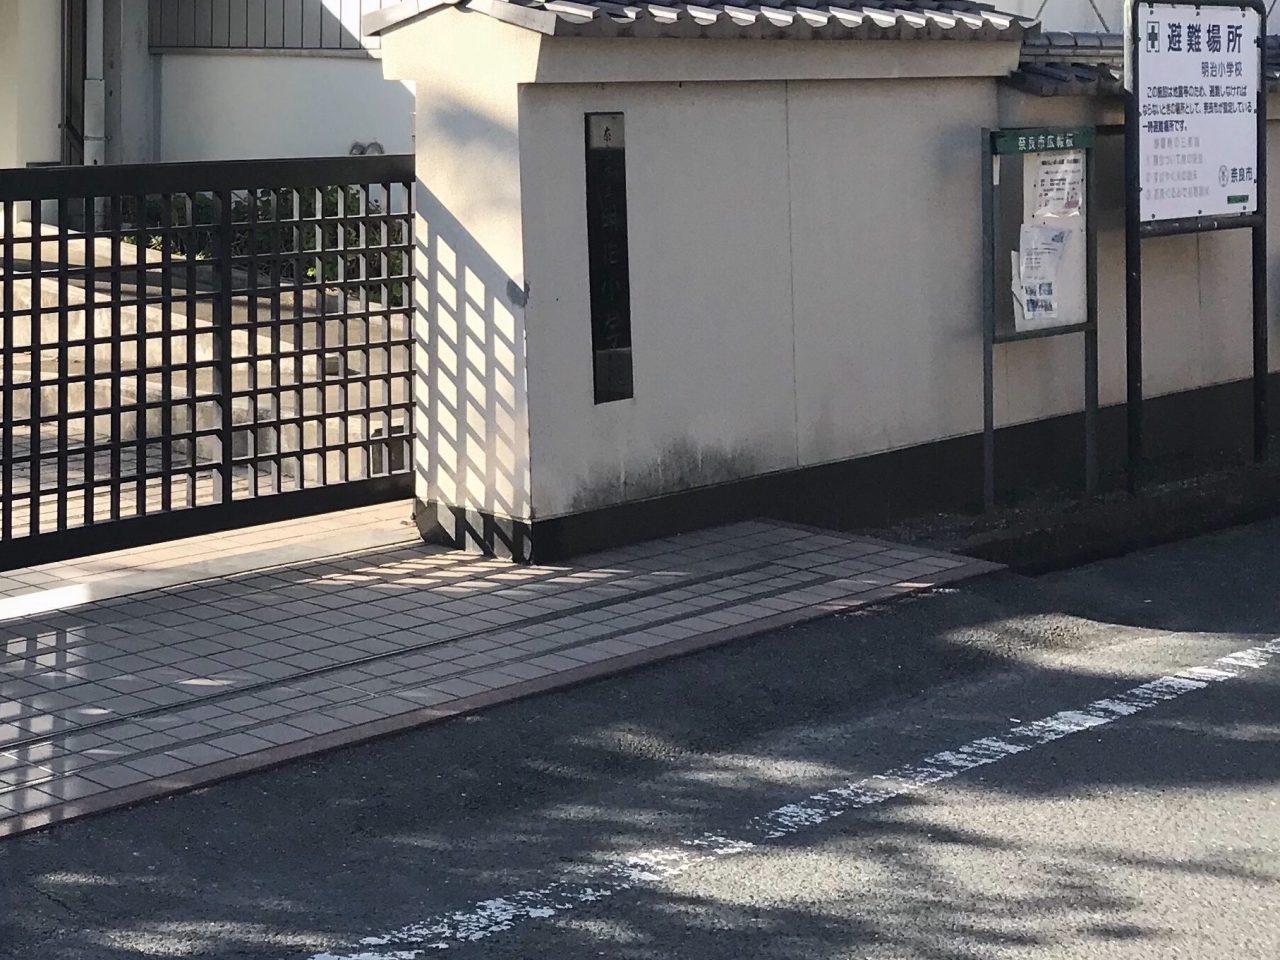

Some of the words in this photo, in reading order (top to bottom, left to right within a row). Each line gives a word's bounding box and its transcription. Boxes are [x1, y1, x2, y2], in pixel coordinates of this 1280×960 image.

[1167, 23, 1243, 53] 避難場所
[1201, 61, 1243, 78] 明治小学校
[1231, 166, 1253, 183] 奈良市
